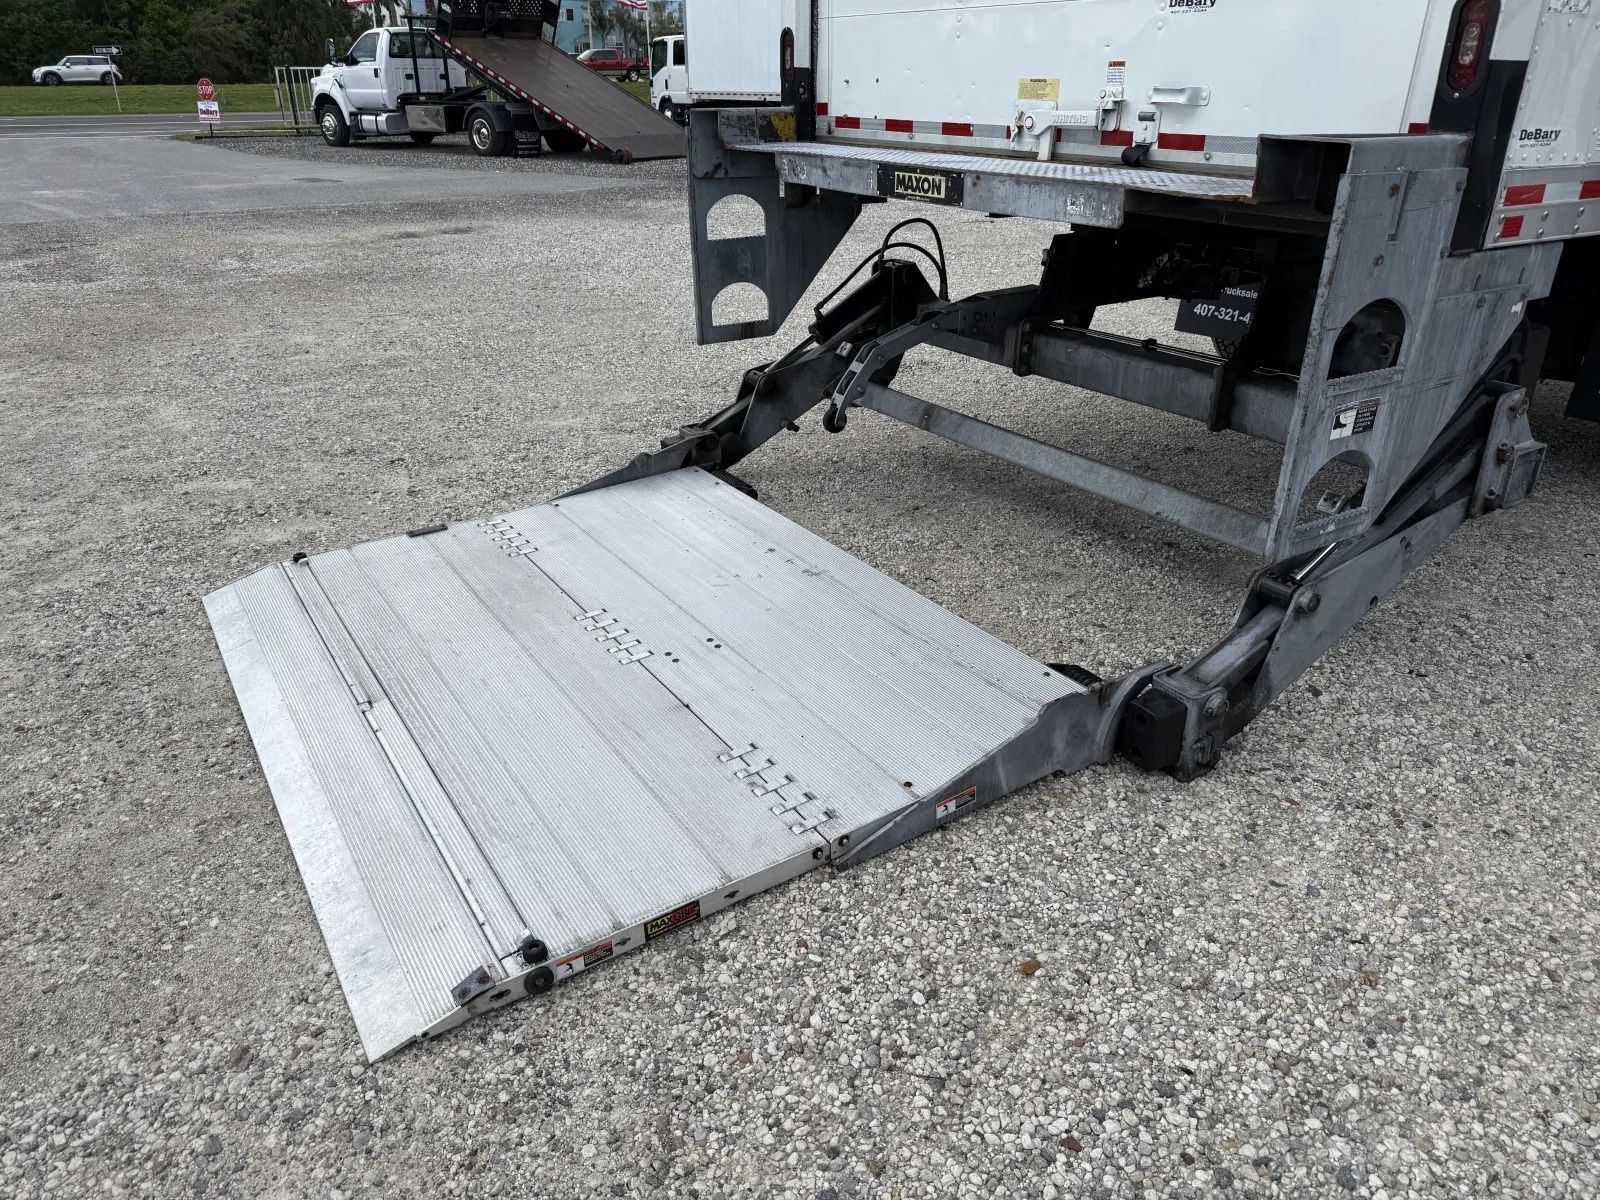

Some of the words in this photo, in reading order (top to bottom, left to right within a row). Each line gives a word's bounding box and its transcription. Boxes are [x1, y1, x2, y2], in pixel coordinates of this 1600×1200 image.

[198, 86, 212, 94] STOP
[1051, 113, 1087, 124] WHITING
[1519, 128, 1561, 141] DeBary
[895, 173, 943, 196] MAXON
[1221, 287, 1258, 299] rucksale
[1193, 303, 1254, 324] 407-321-4
